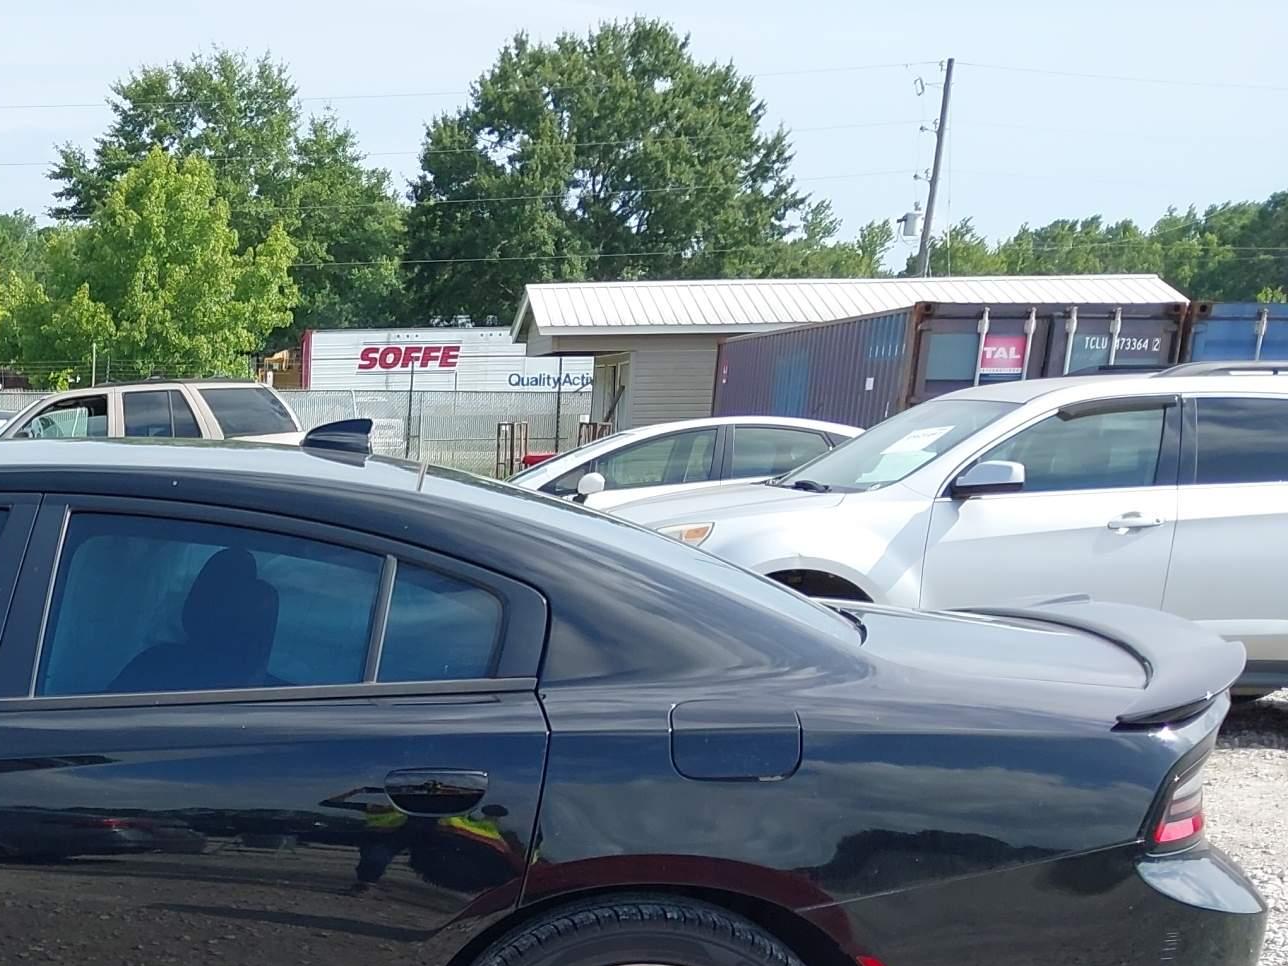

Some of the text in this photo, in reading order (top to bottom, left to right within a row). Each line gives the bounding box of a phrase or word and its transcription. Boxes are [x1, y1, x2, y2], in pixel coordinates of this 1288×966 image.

[1084, 336, 1109, 349] TCLU
[357, 345, 461, 370] SOFFE
[983, 346, 1021, 359] TAL
[508, 373, 559, 389] Quality
